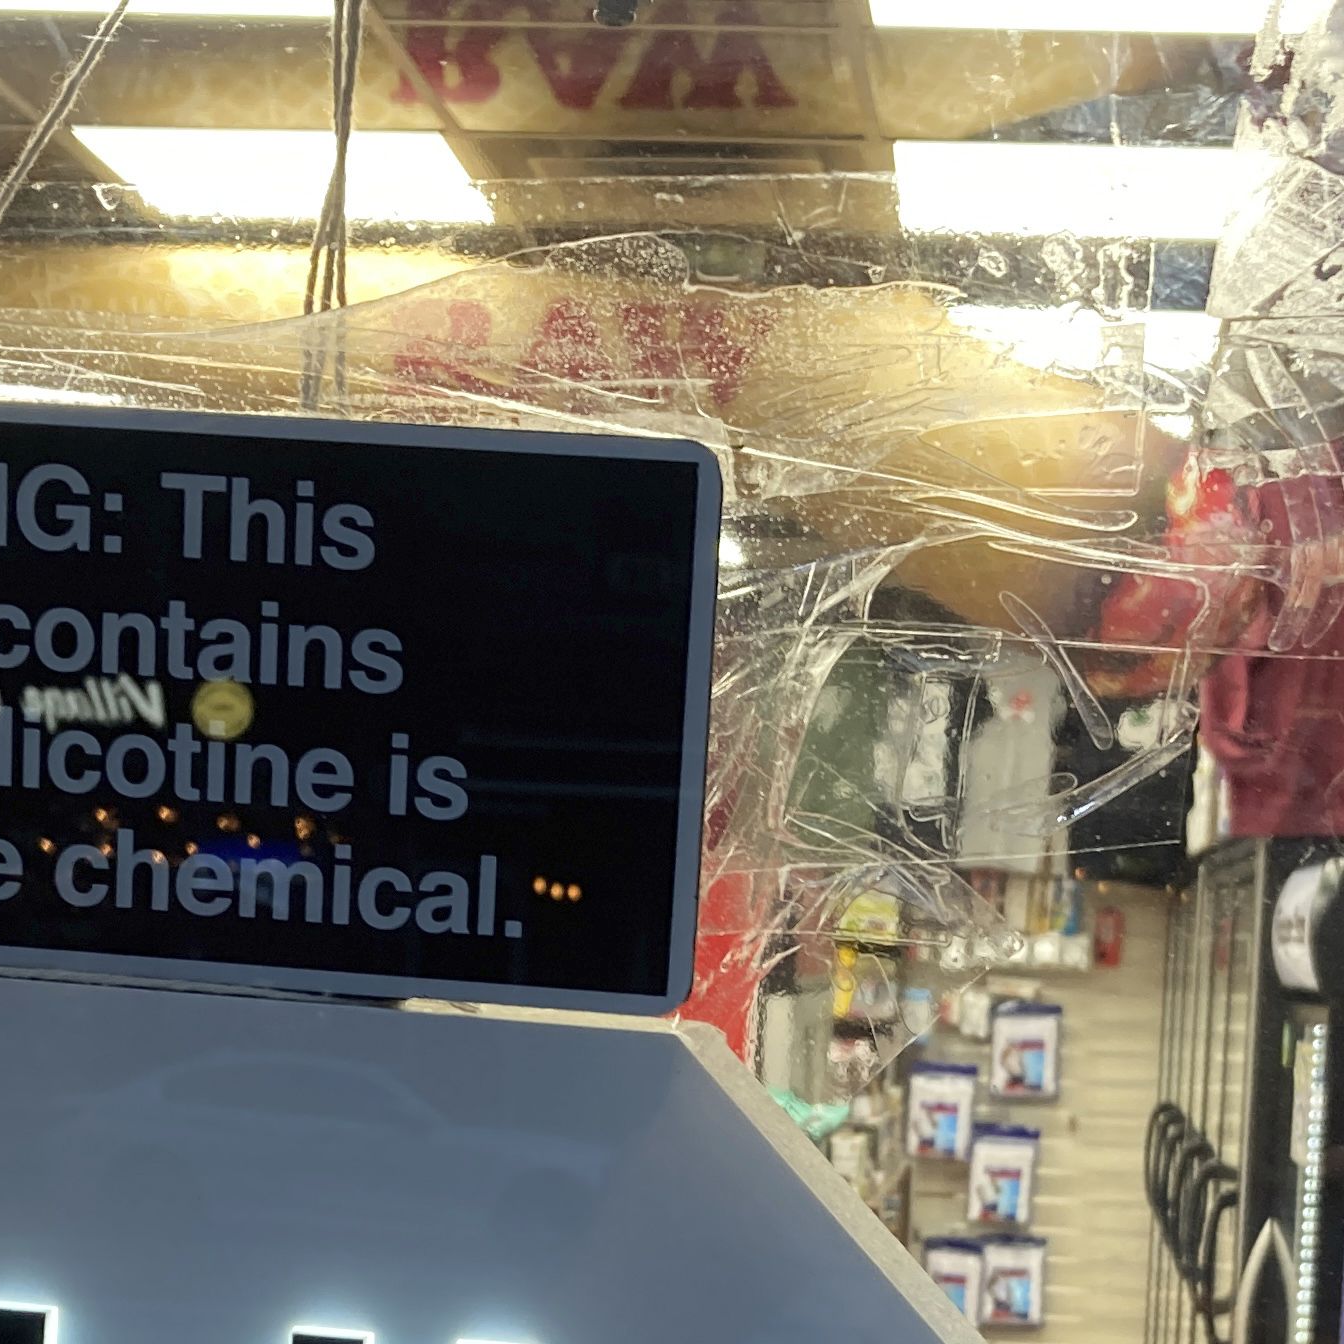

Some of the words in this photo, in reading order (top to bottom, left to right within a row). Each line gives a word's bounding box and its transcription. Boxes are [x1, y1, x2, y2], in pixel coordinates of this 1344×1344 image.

[160, 472, 376, 571] This
[389, 732, 469, 821] is
[54, 828, 523, 939] chemical.
